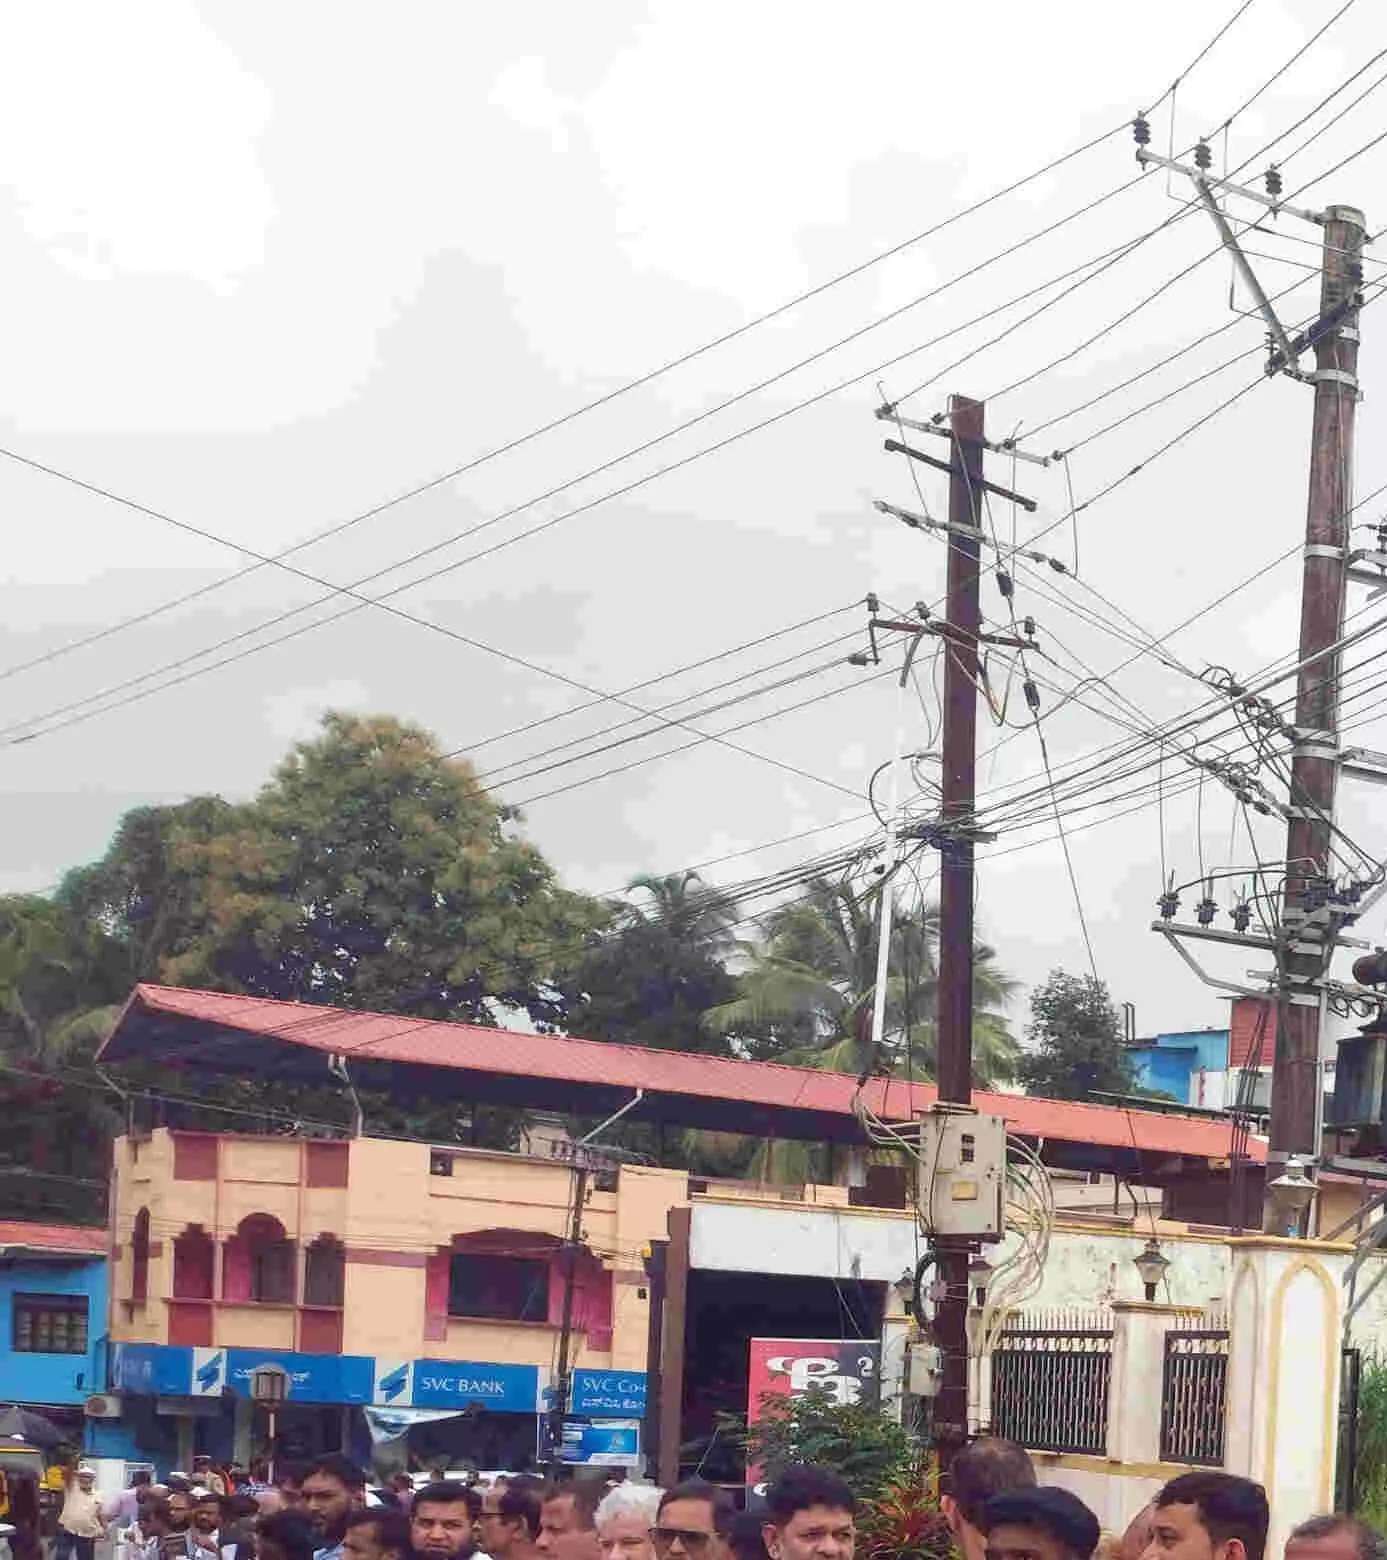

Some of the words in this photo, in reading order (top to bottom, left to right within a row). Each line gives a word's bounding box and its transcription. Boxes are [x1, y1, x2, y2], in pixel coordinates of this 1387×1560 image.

[422, 1376, 454, 1393] SVC
[458, 1378, 505, 1395] BANK
[583, 1376, 615, 1393] SVC
